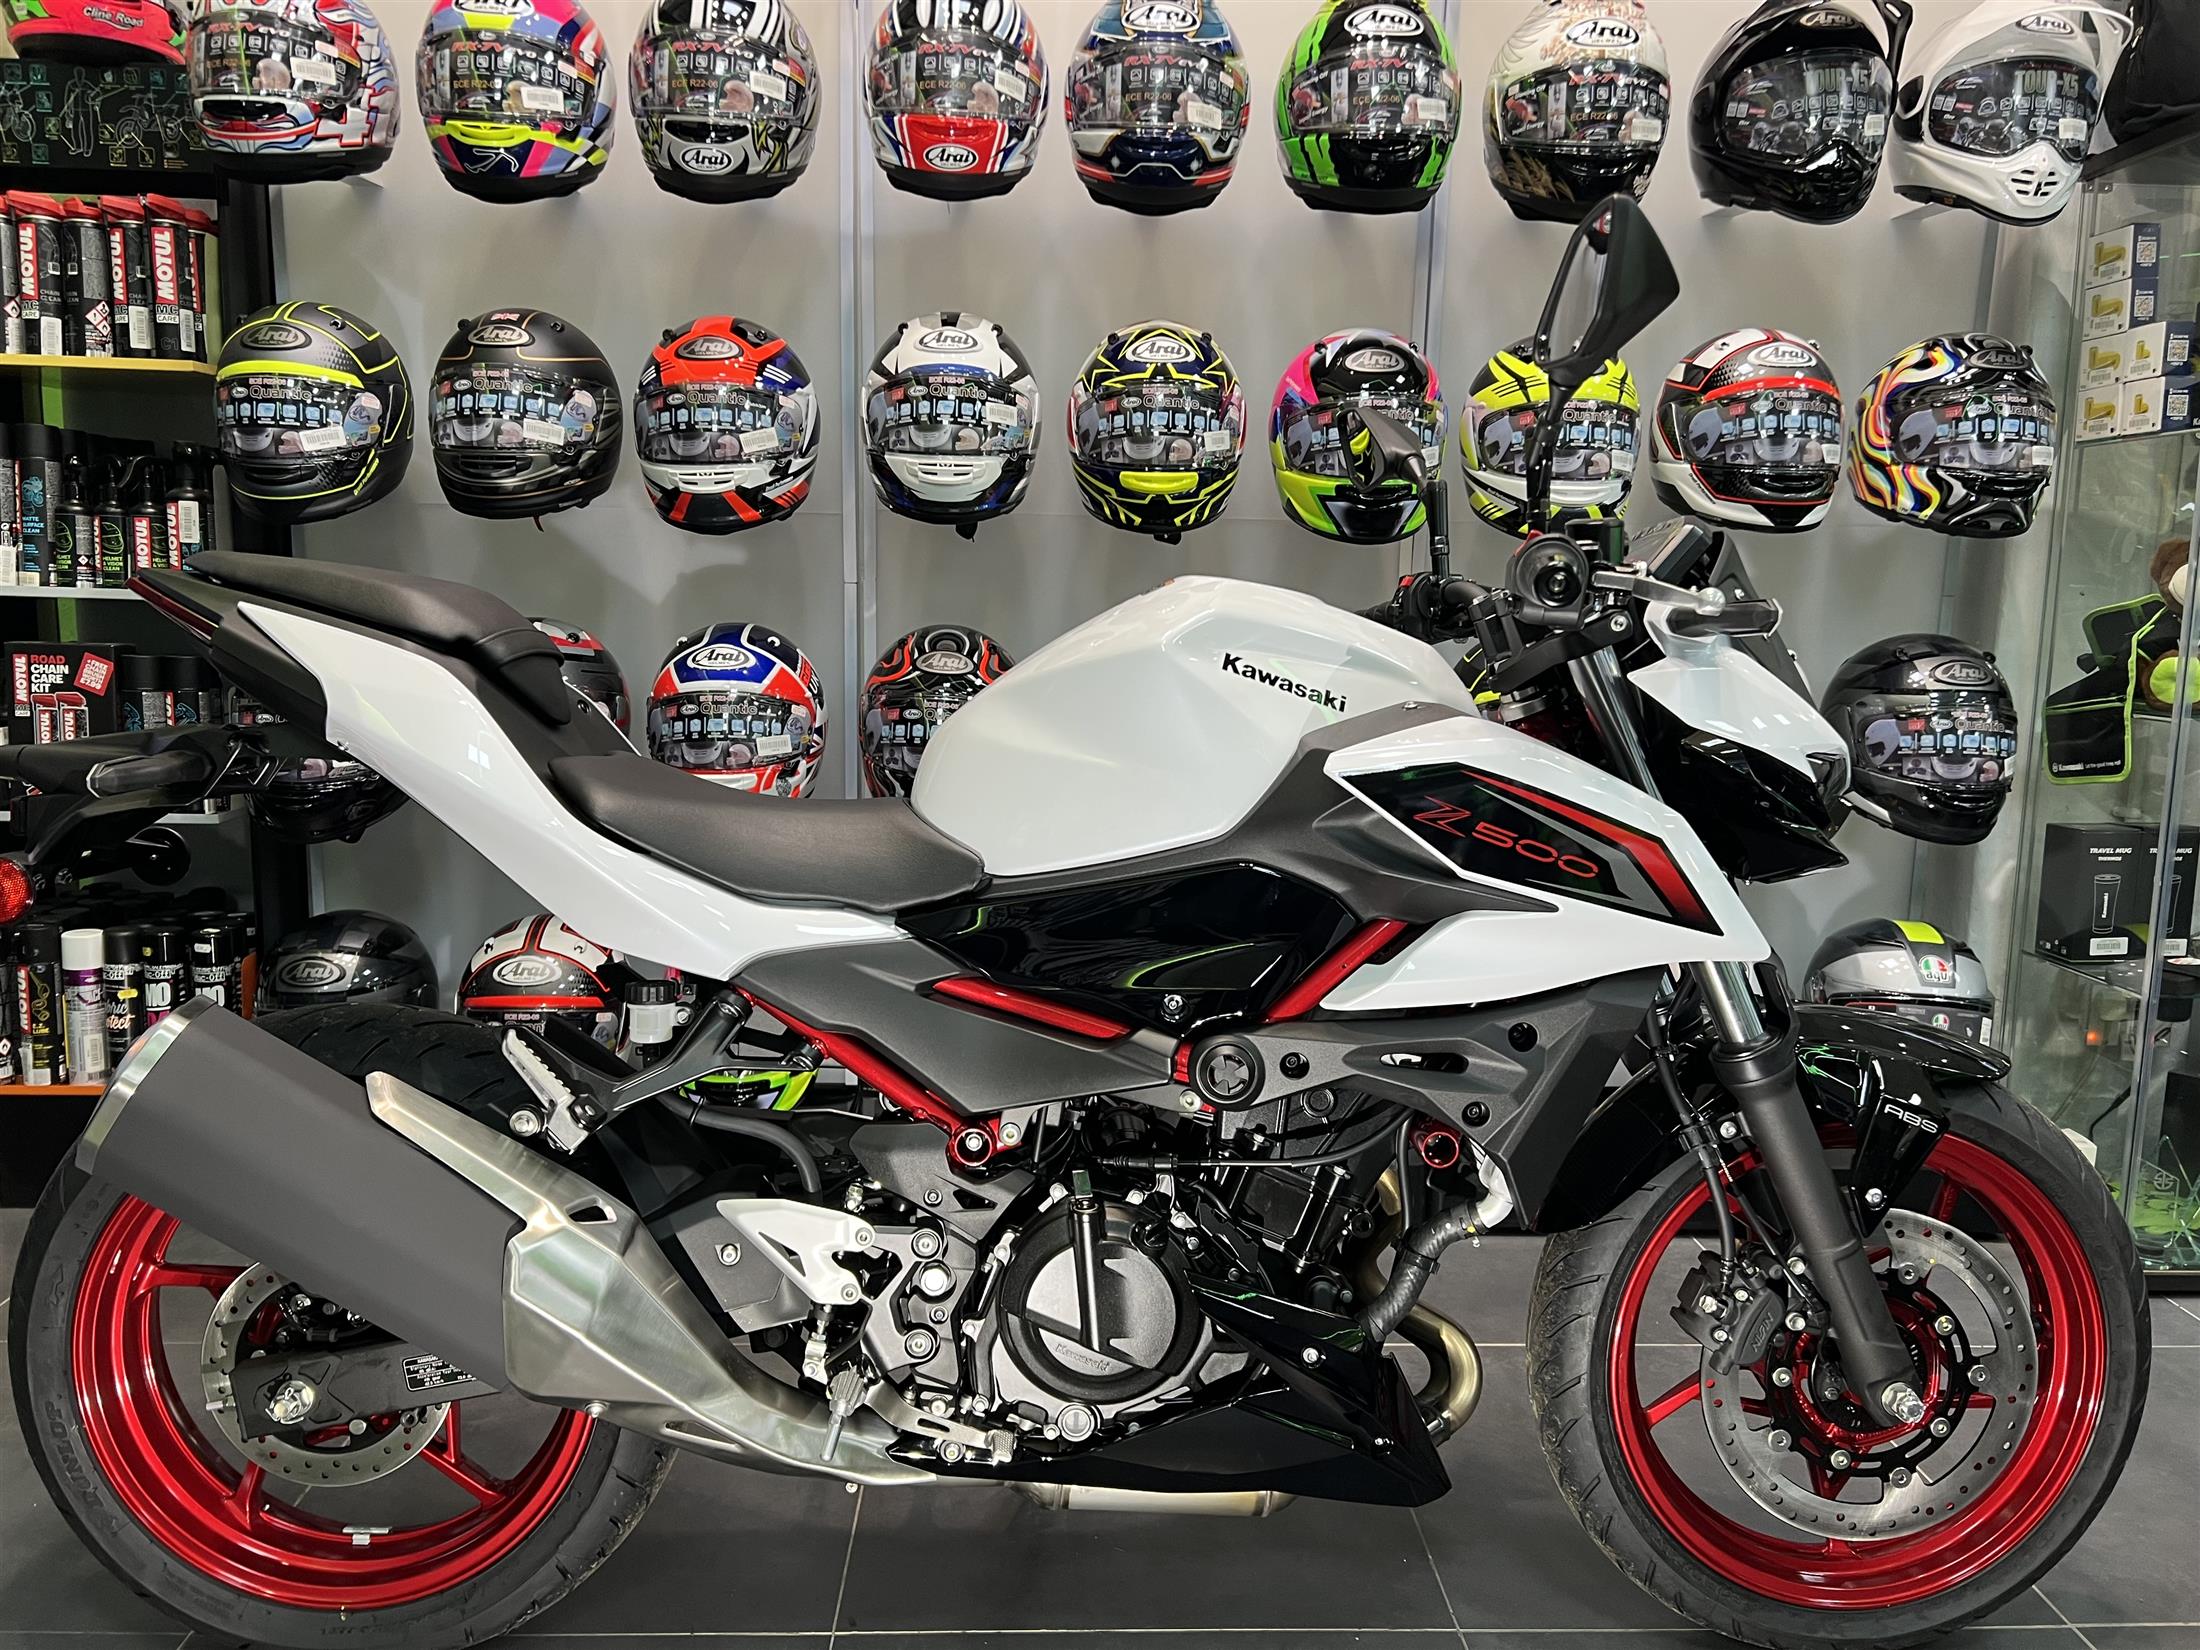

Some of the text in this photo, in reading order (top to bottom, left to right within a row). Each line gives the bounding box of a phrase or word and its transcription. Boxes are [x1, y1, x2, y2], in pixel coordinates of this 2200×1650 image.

[83, 6, 144, 28] Cline Road
[1352, 10, 1414, 30] Arai
[2022, 16, 2067, 31] Arai
[1576, 21, 1633, 39] Arai
[688, 150, 726, 166] Arai
[930, 149, 971, 163] Arai
[20, 226, 35, 297] MOTUL
[110, 232, 124, 301] MOTUL
[154, 231, 175, 301] MOTUL
[156, 304, 179, 315] MC
[244, 327, 297, 342] Arai
[475, 326, 519, 341] Arai
[927, 331, 971, 347] Arai
[1137, 341, 1183, 356] Arai
[1768, 345, 1807, 360] Arai
[1356, 351, 1399, 367] Arai
[250, 385, 312, 400] Quantic
[473, 378, 533, 394] Quantic
[929, 383, 987, 401] Quantic
[686, 391, 747, 405] Quantic
[1774, 398, 1828, 413] Quantic
[1563, 409, 1617, 424] Quantic
[135, 519, 150, 569] MOTUL
[167, 506, 179, 567] MOTUL
[30, 655, 65, 664] ROAD
[694, 649, 743, 663] Arai
[922, 652, 966, 669] Arai
[30, 664, 69, 675] CHAIN
[1945, 663, 1987, 679] Arai
[15, 655, 28, 702] MOTUL
[31, 674, 64, 684] CARE
[1221, 652, 1348, 714] Kawasaki
[31, 684, 51, 693] KIT
[700, 702, 758, 715] Quantic
[64, 710, 74, 741] OTUL
[1954, 719, 2005, 733] Quantic
[290, 962, 335, 980] Arai
[503, 962, 547, 977] Arai
[17, 967, 30, 1030] MOTUL
[1884, 1103, 1939, 1134] ABS
